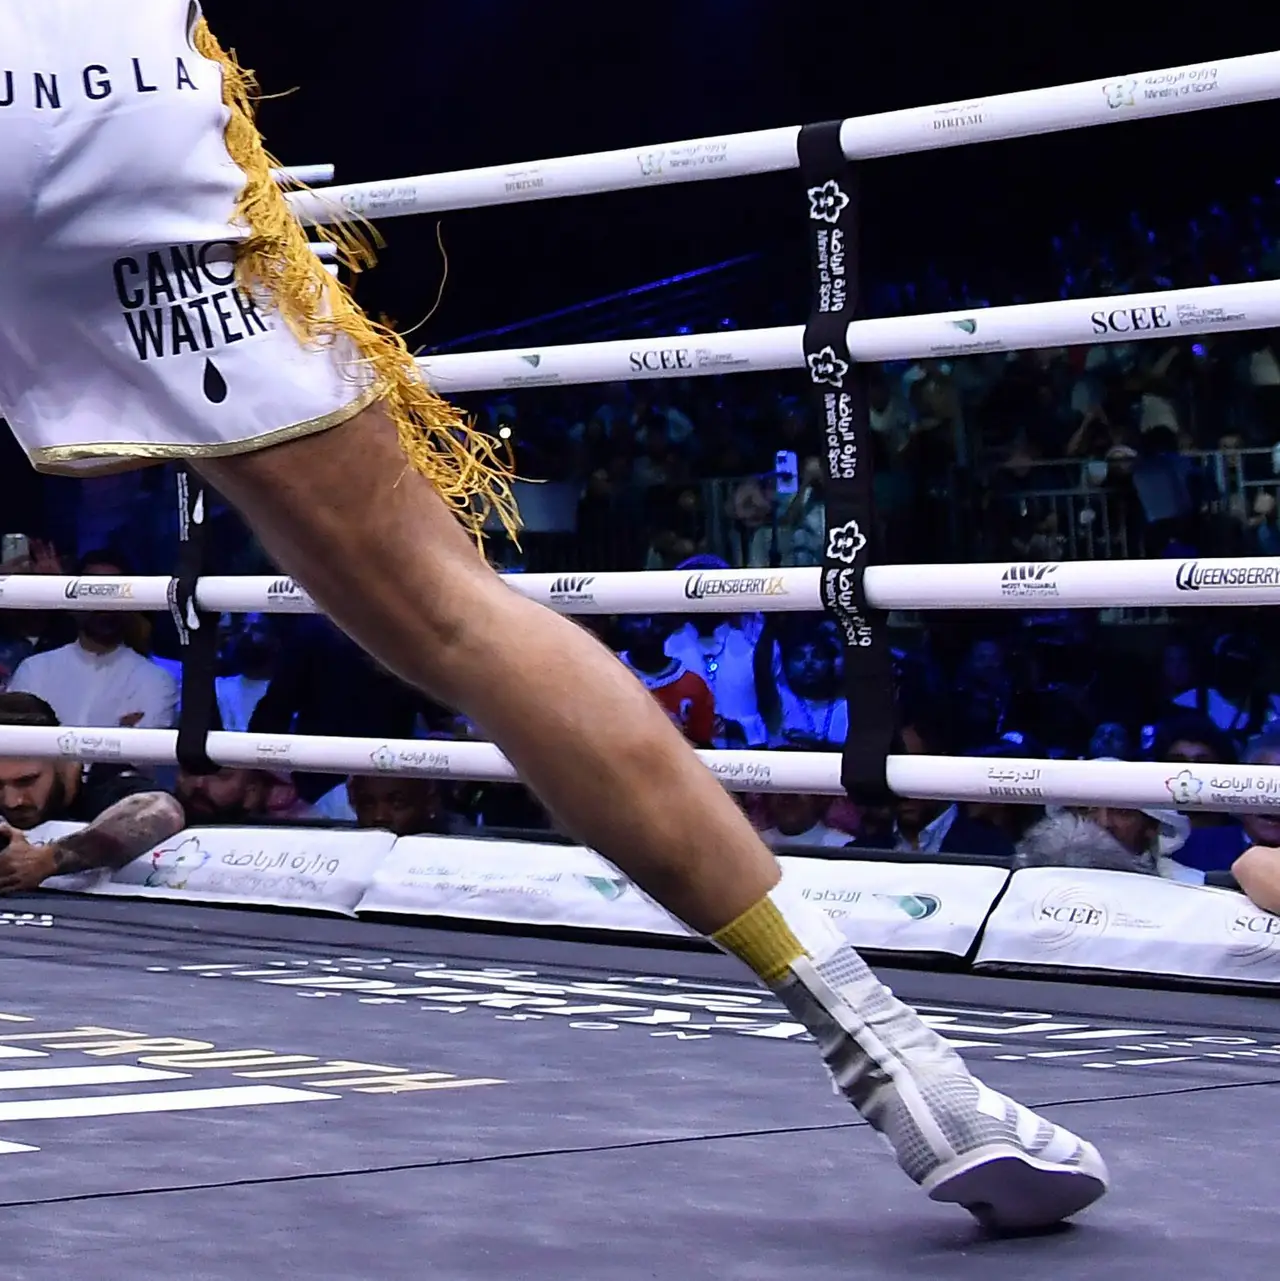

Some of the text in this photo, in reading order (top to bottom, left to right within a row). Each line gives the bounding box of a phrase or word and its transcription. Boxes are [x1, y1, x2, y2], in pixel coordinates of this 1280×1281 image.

[122, 288, 268, 361] WATER
[1091, 305, 1171, 335] SCEE
[630, 349, 692, 371] SCEE
[824, 393, 838, 433] Ministry
[827, 448, 841, 478] Sport
[684, 574, 768, 599] QUEENSBERRY
[1176, 562, 1280, 591] QUEENSBERRY
[222, 848, 341, 876] وزارة الرياضة
[1040, 906, 1102, 927] SCEE
[257, 976, 1002, 1049] DIRIYA
